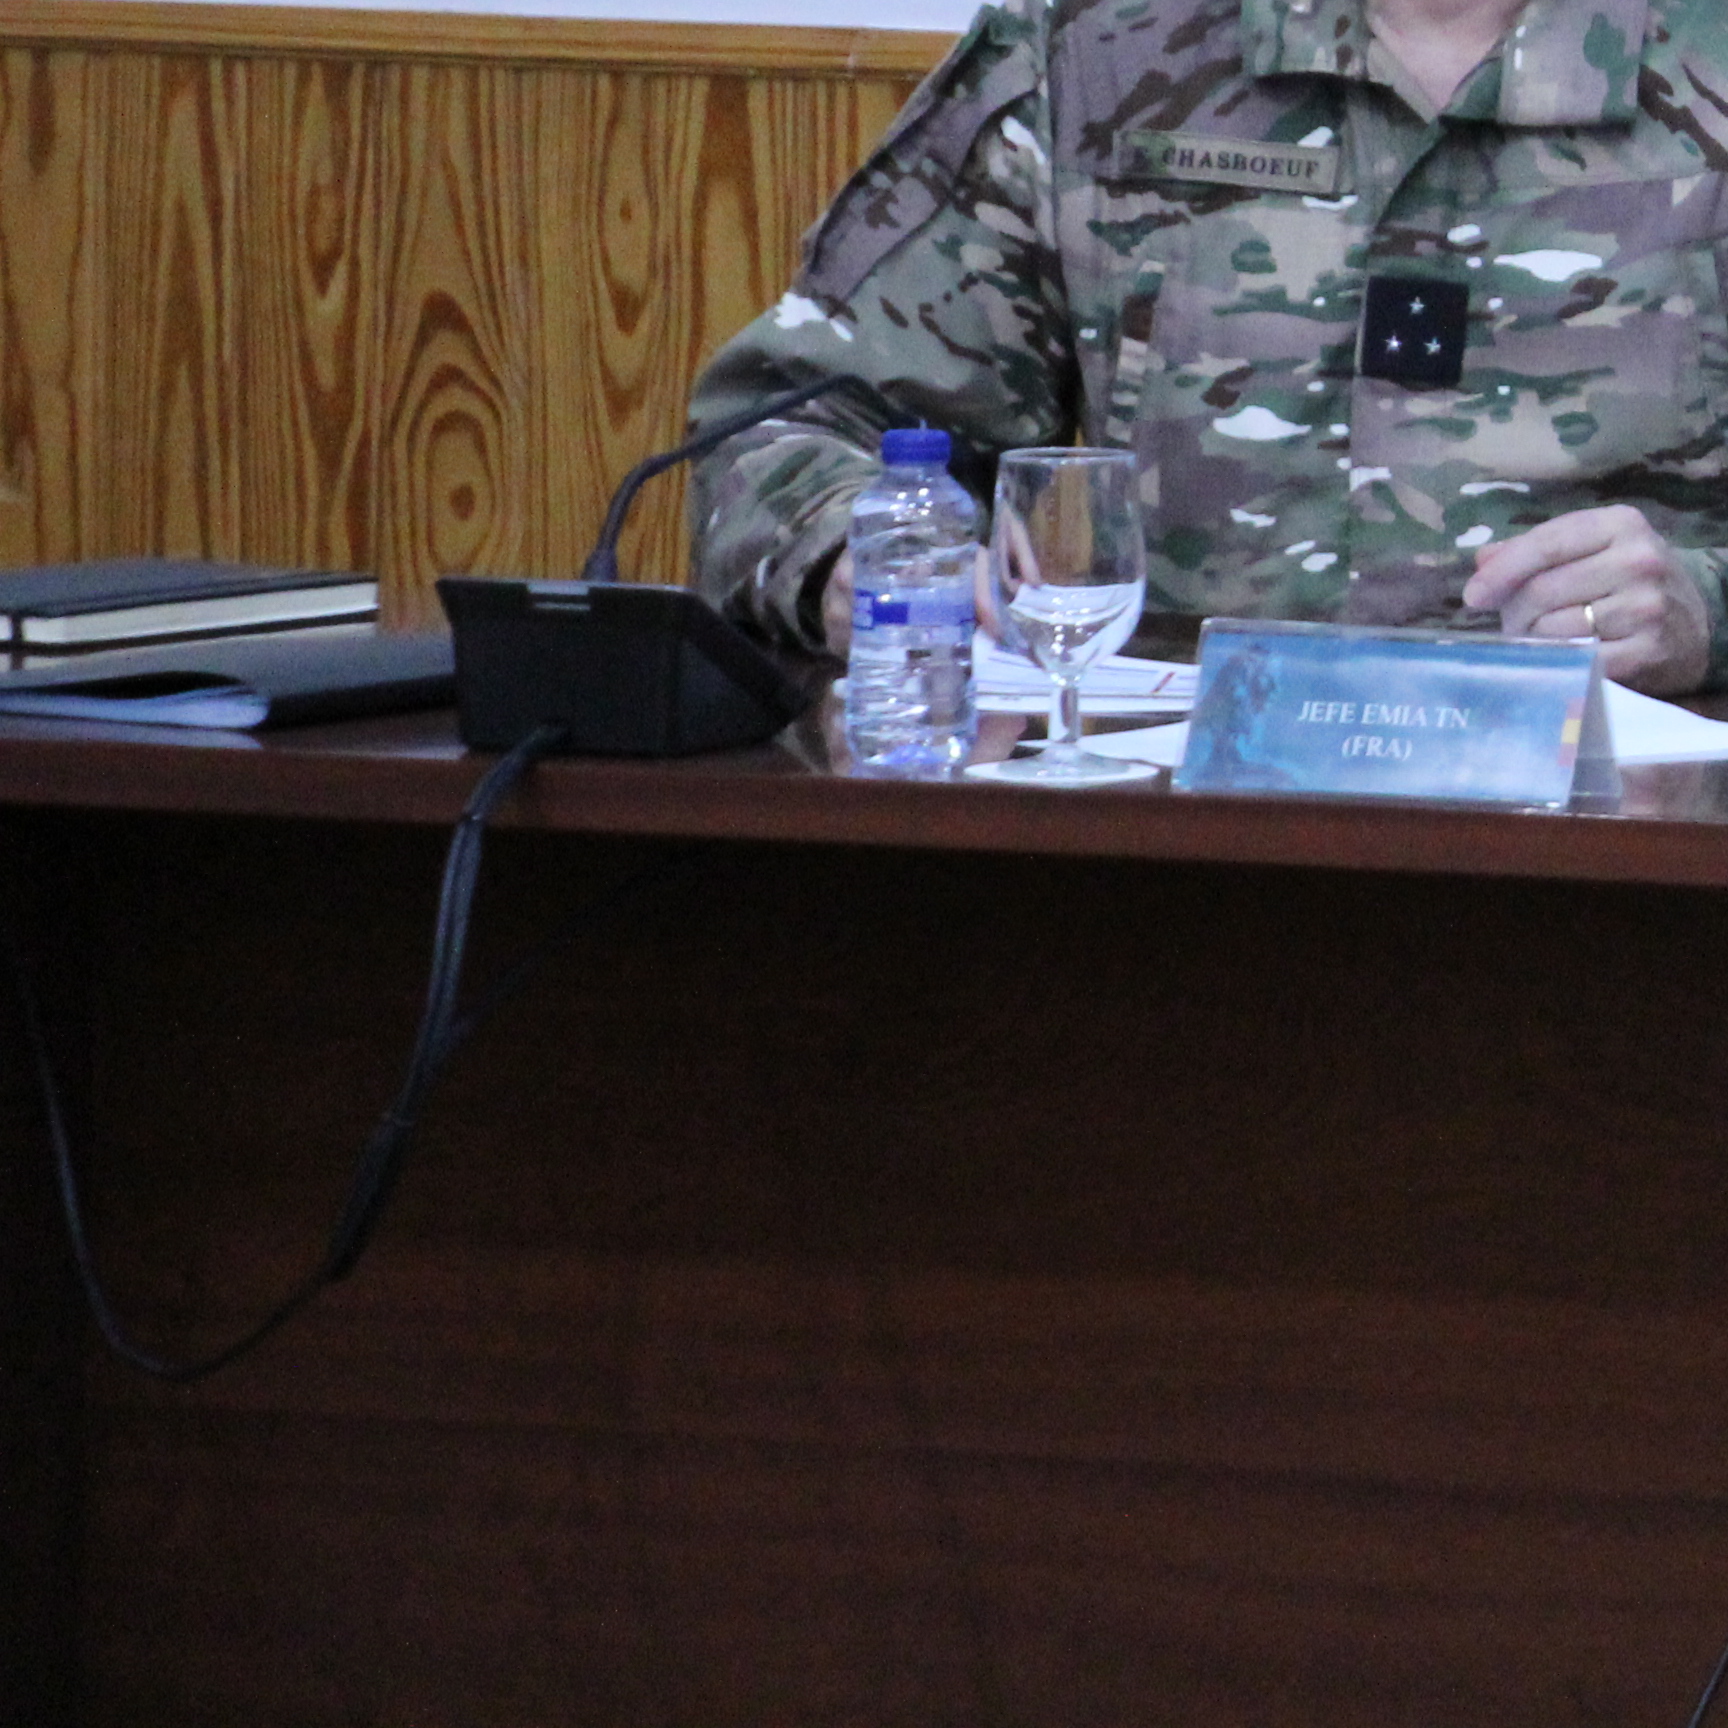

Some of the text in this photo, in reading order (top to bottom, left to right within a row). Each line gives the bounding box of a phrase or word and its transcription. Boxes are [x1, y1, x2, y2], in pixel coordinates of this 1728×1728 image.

[1162, 144, 1320, 179] CHASBOEUF
[1297, 700, 1470, 729] JEFE EMIA TN
[1340, 734, 1413, 761] (FRA)
